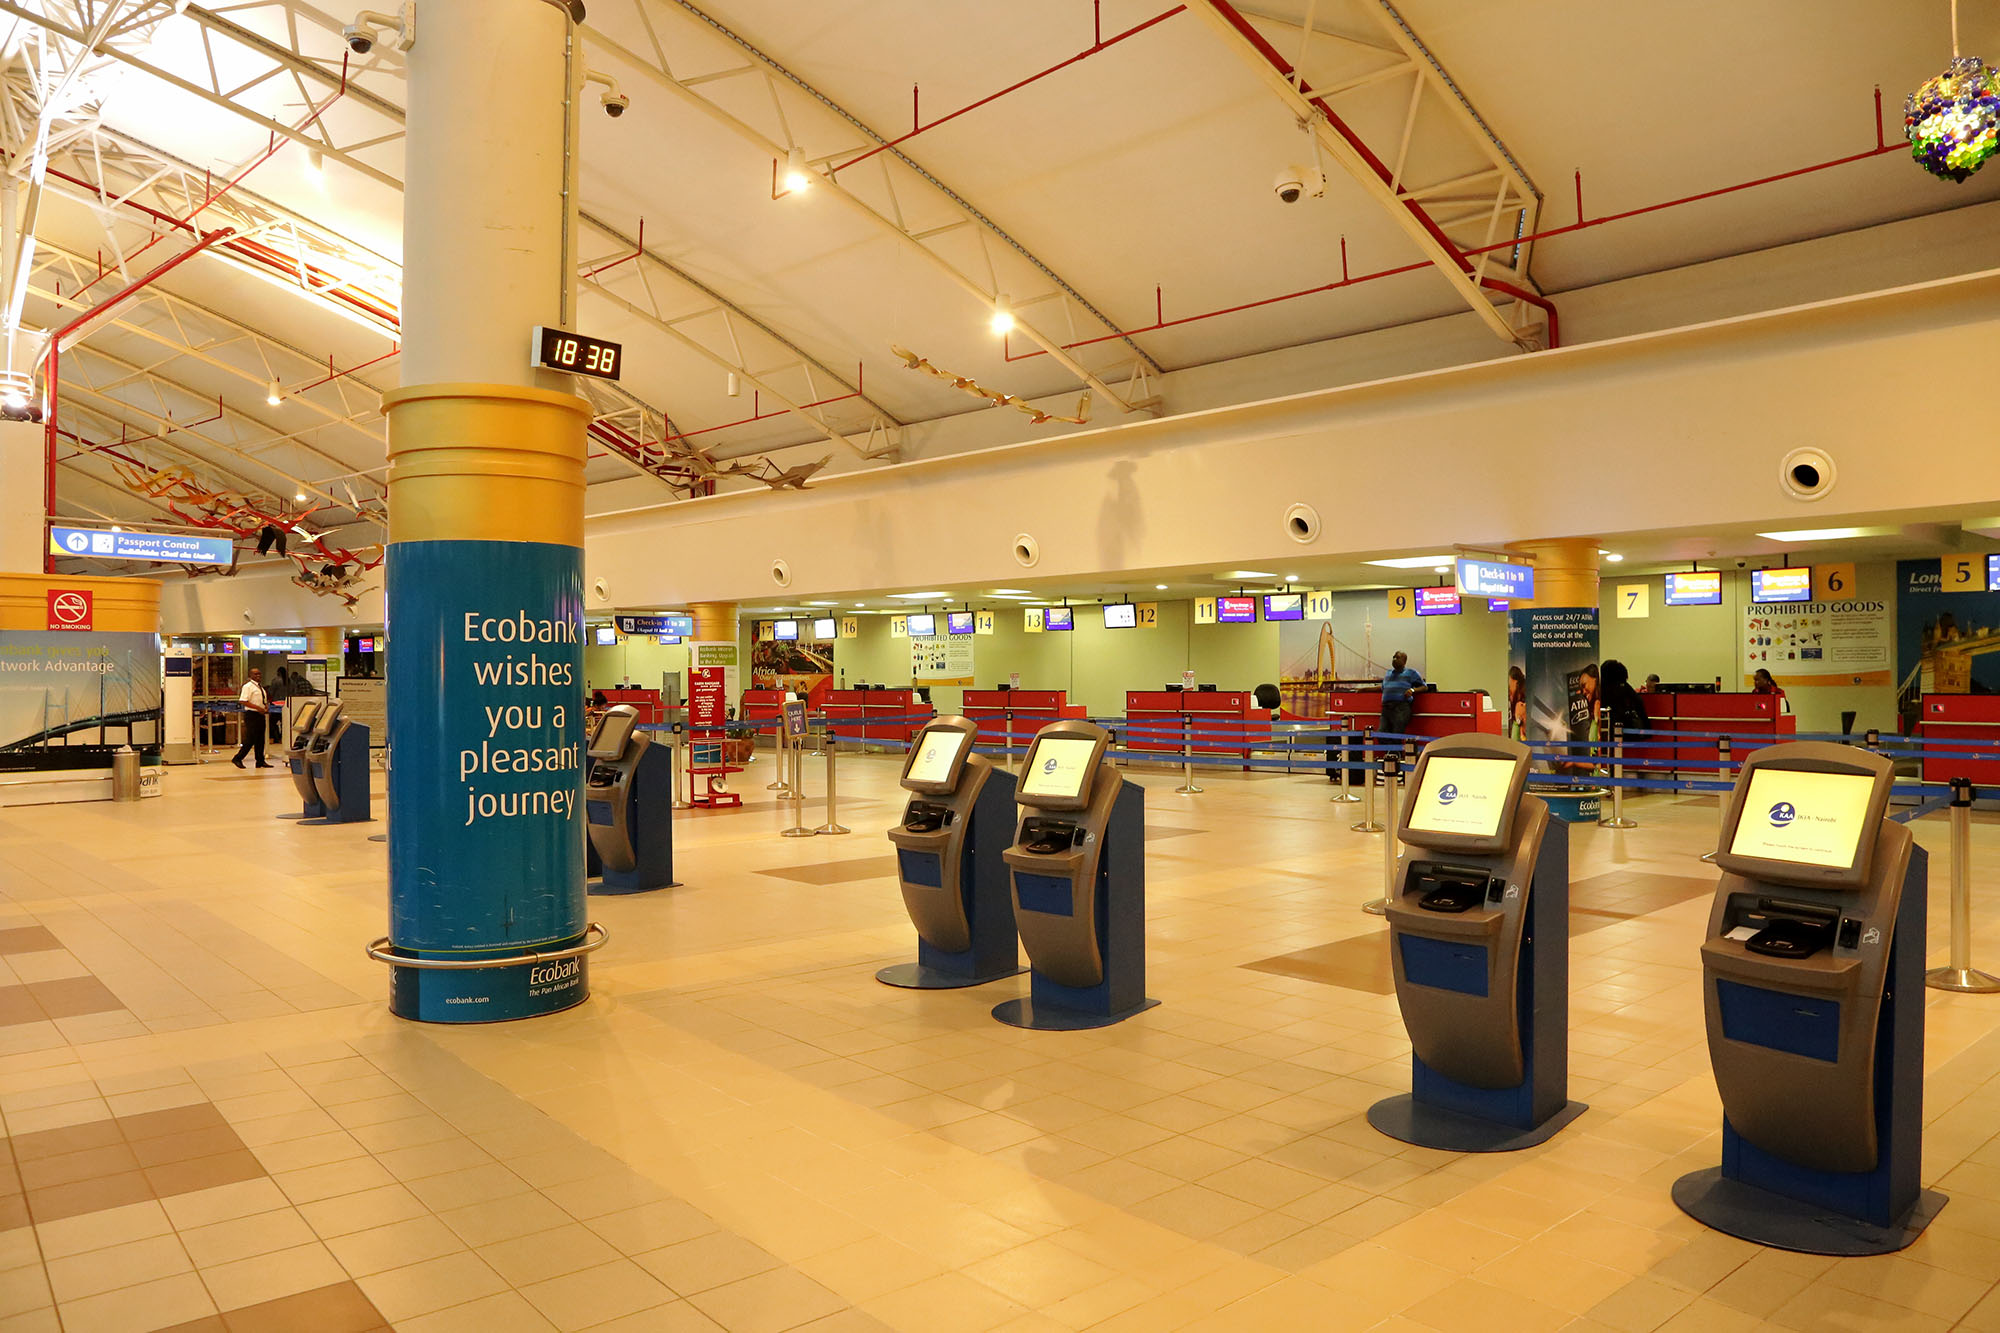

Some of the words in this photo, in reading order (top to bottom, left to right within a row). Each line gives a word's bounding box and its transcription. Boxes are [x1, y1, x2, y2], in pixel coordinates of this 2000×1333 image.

[555, 339, 615, 373] 18:38
[117, 536, 160, 548] Passport
[162, 539, 199, 550] Control
[1480, 567, 1505, 580] Check-in
[1506, 571, 1509, 581] 1
[1511, 571, 1517, 581] to
[1955, 562, 1971, 583] 5
[1828, 571, 1843, 592] 6
[1311, 598, 1329, 613] 10
[1396, 595, 1406, 612] 9
[1626, 592, 1638, 610] 7
[1748, 603, 1827, 616] PROHIBITED
[1831, 600, 1885, 613] GOODS
[1139, 609, 1155, 623] 12
[1198, 603, 1213, 618] 11
[464, 609, 577, 643] Ecobank
[844, 622, 855, 633] 16
[893, 620, 906, 633] 15
[978, 617, 992, 630] 14
[1027, 615, 1041, 628] 13
[760, 625, 772, 636] 17
[47, 646, 83, 659] gives
[45, 660, 114, 674] Advantage
[473, 653, 572, 686] wishes
[752, 666, 778, 677] Africa.
[1571, 699, 1588, 711] ATM
[485, 705, 542, 738] you
[552, 705, 566, 728] a
[460, 740, 579, 782] pleasant
[465, 786, 575, 826] journey
[1580, 800, 1600, 811] Ecoban
[1815, 815, 1837, 823] Nairobi
[530, 956, 580, 985] Ecobank
[529, 989, 540, 997] The
[541, 987, 552, 995] Pan
[553, 982, 570, 992] African
